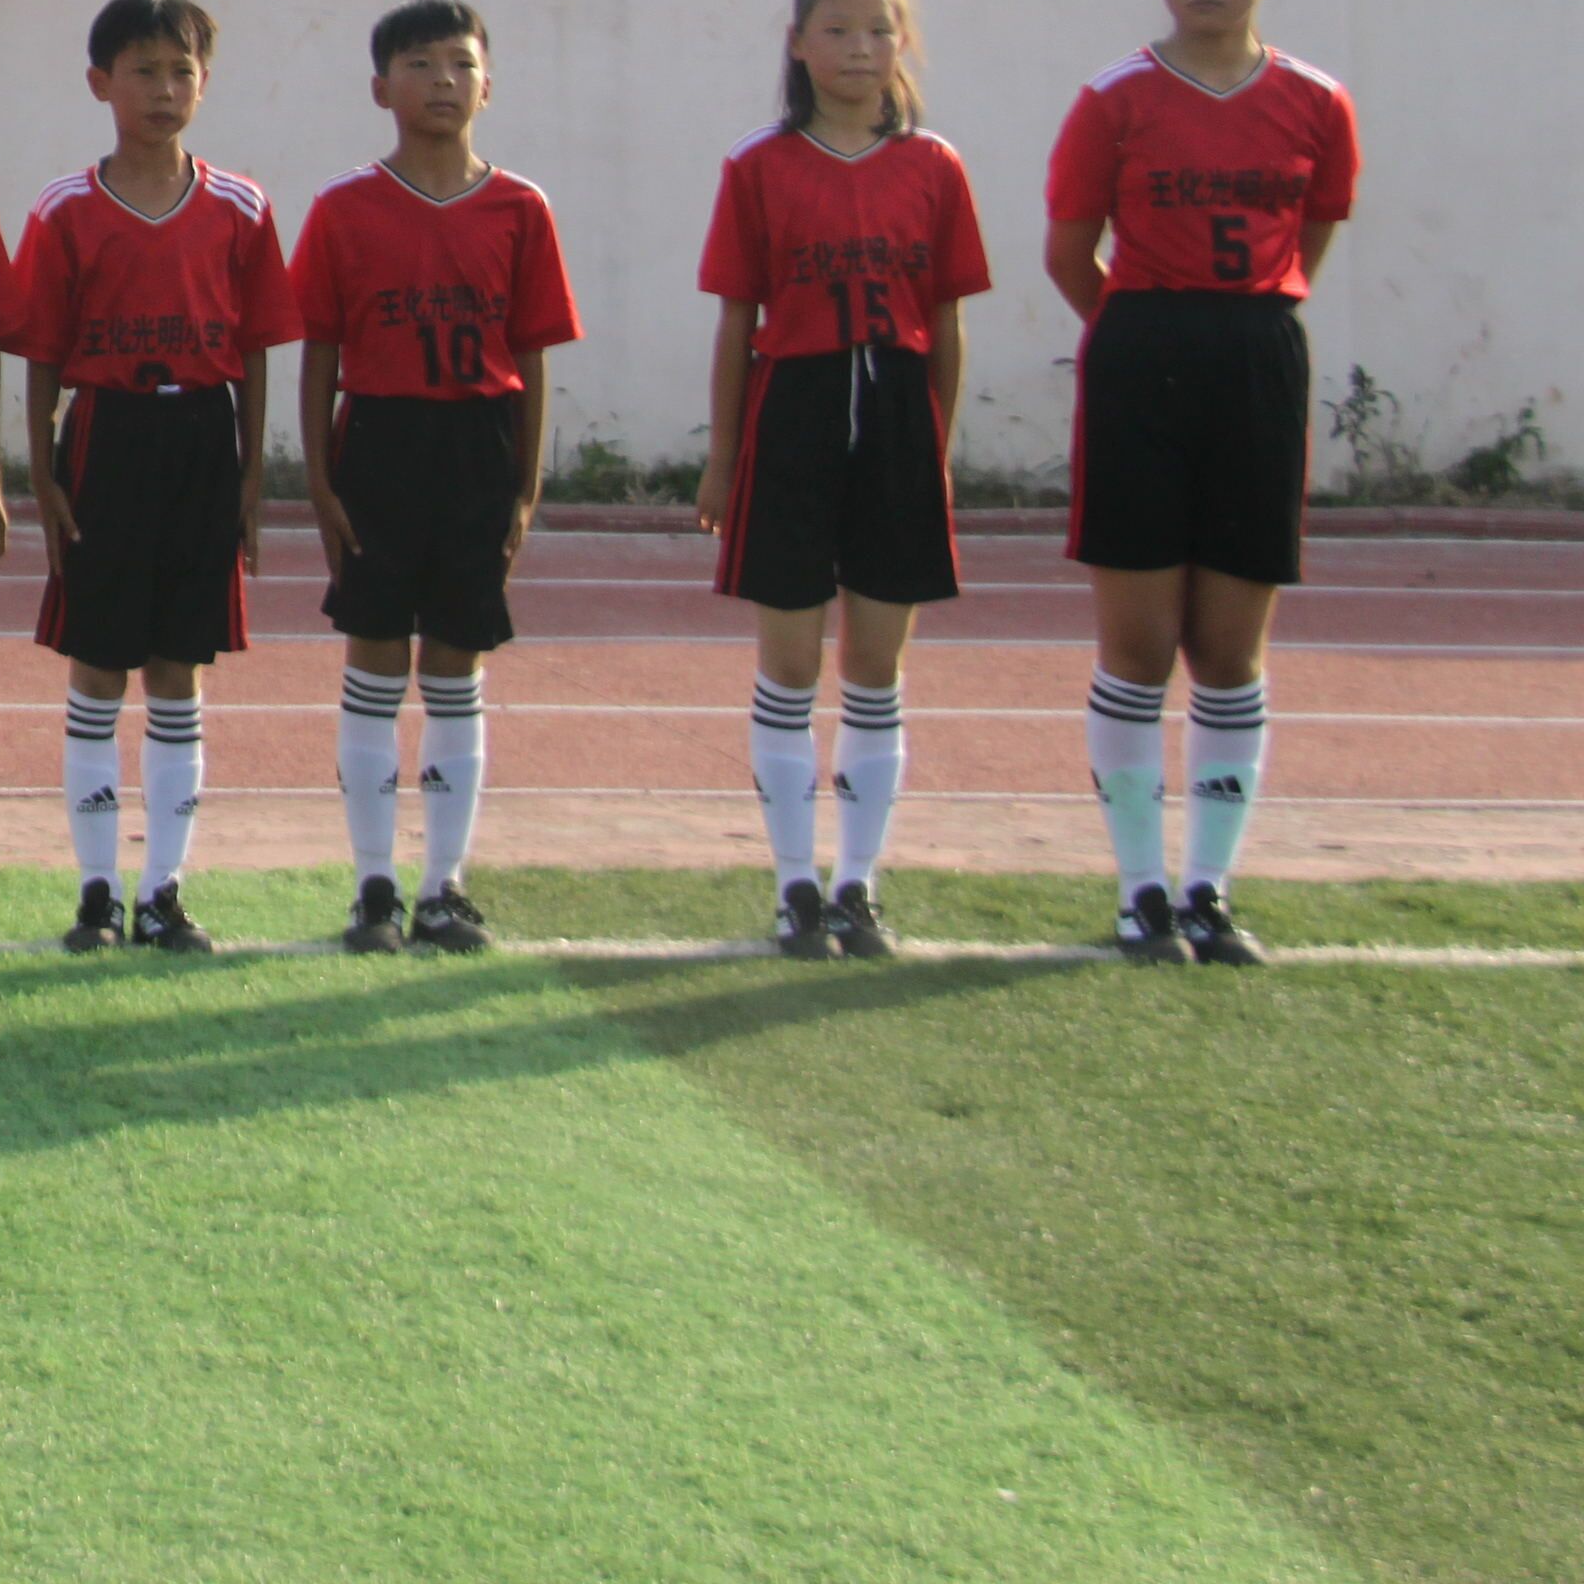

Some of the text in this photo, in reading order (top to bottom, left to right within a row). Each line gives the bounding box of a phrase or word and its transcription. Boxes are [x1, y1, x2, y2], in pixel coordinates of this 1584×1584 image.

[1211, 215, 1251, 282] 5
[81, 314, 226, 358] 王化光明小学
[828, 281, 898, 347] 15
[417, 322, 486, 389] 10
